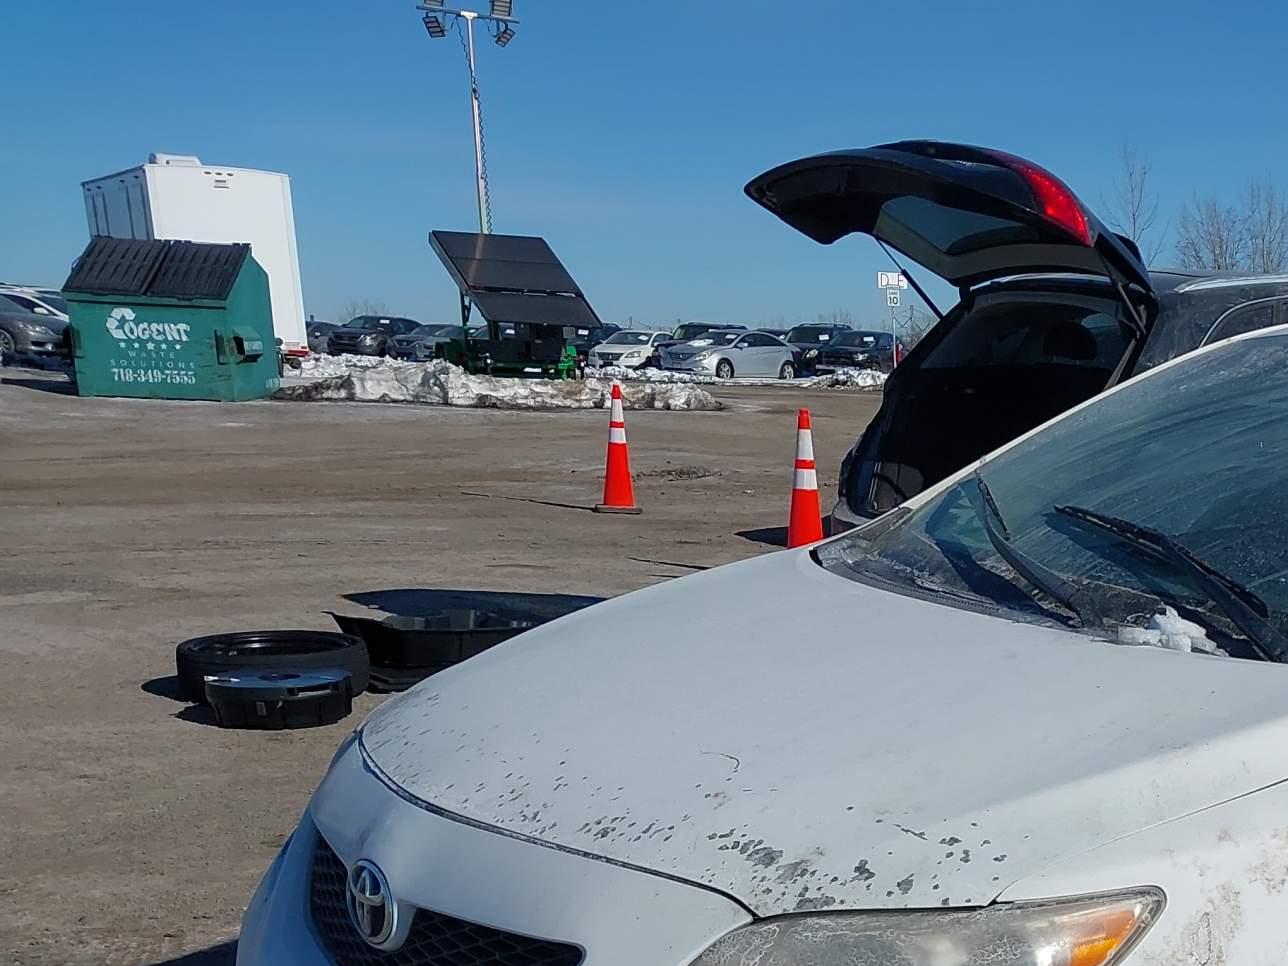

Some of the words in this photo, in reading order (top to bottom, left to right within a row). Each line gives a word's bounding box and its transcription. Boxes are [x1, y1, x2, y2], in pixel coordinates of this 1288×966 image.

[889, 296, 898, 305] 10
[128, 350, 175, 359] WASTE
[110, 359, 195, 369] SOLUTIONS
[111, 368, 196, 385] 718-349-7555
